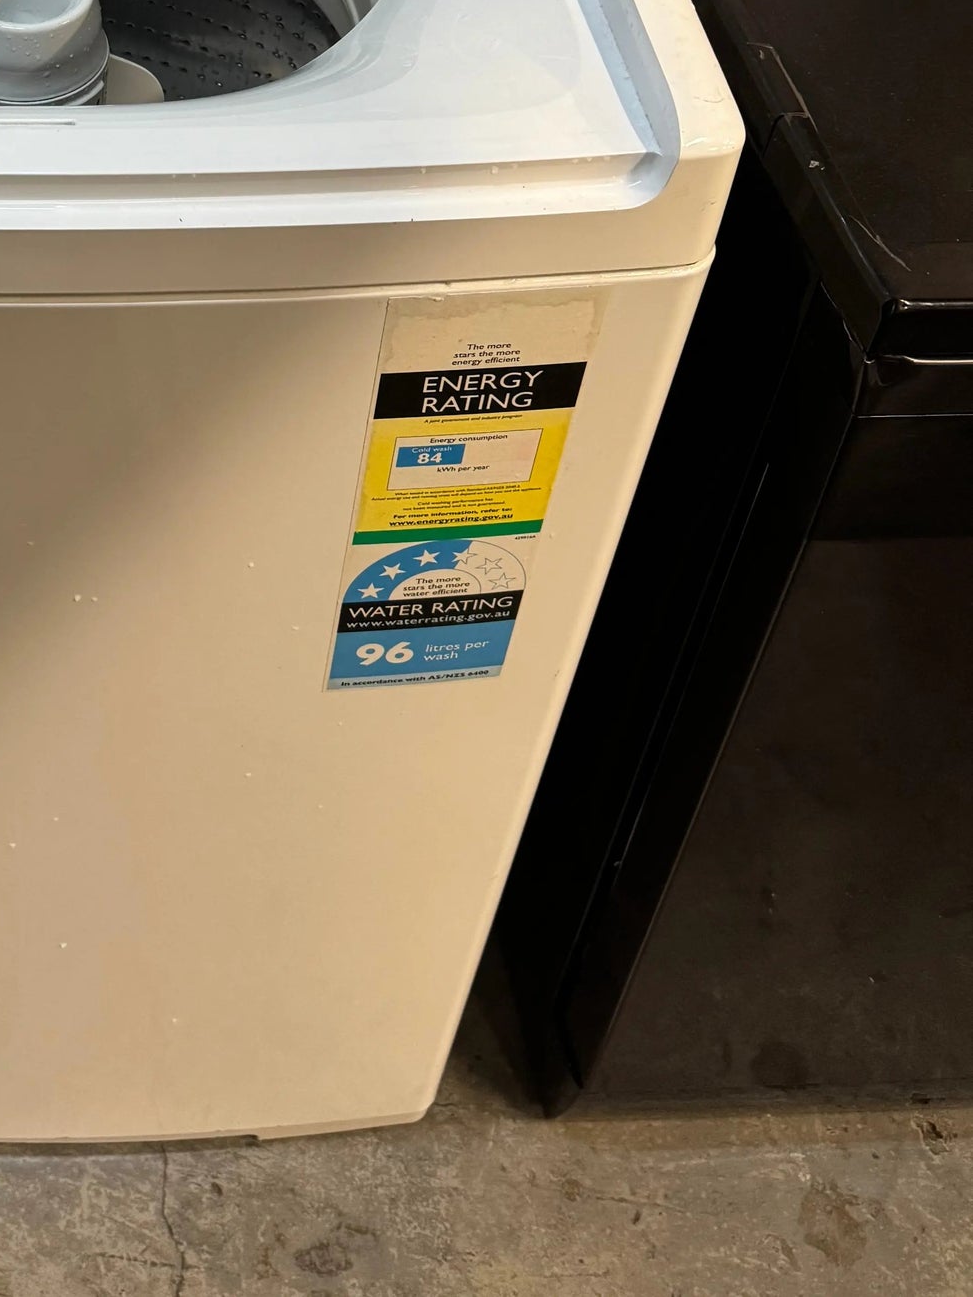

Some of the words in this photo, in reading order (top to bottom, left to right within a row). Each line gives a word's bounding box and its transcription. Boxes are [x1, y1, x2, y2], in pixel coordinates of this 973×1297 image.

[487, 342, 512, 350] more
[485, 356, 521, 364] efficient
[423, 370, 544, 393] ENERGY
[421, 391, 534, 414] RATING
[458, 434, 508, 442] consumption
[411, 446, 431, 454] Cold
[417, 452, 443, 464] 84
[389, 513, 514, 527] www.energyrating.gov.au
[432, 588, 468, 596] efficient
[349, 604, 424, 619] WATER
[431, 596, 514, 614] RATING
[346, 610, 511, 629] www.waterrating.gov.au
[425, 643, 460, 652] litres
[464, 640, 489, 652] per
[356, 641, 414, 666] 96
[423, 651, 459, 662] wash
[352, 678, 404, 686] accordance
[428, 672, 466, 681] AS/NZS
